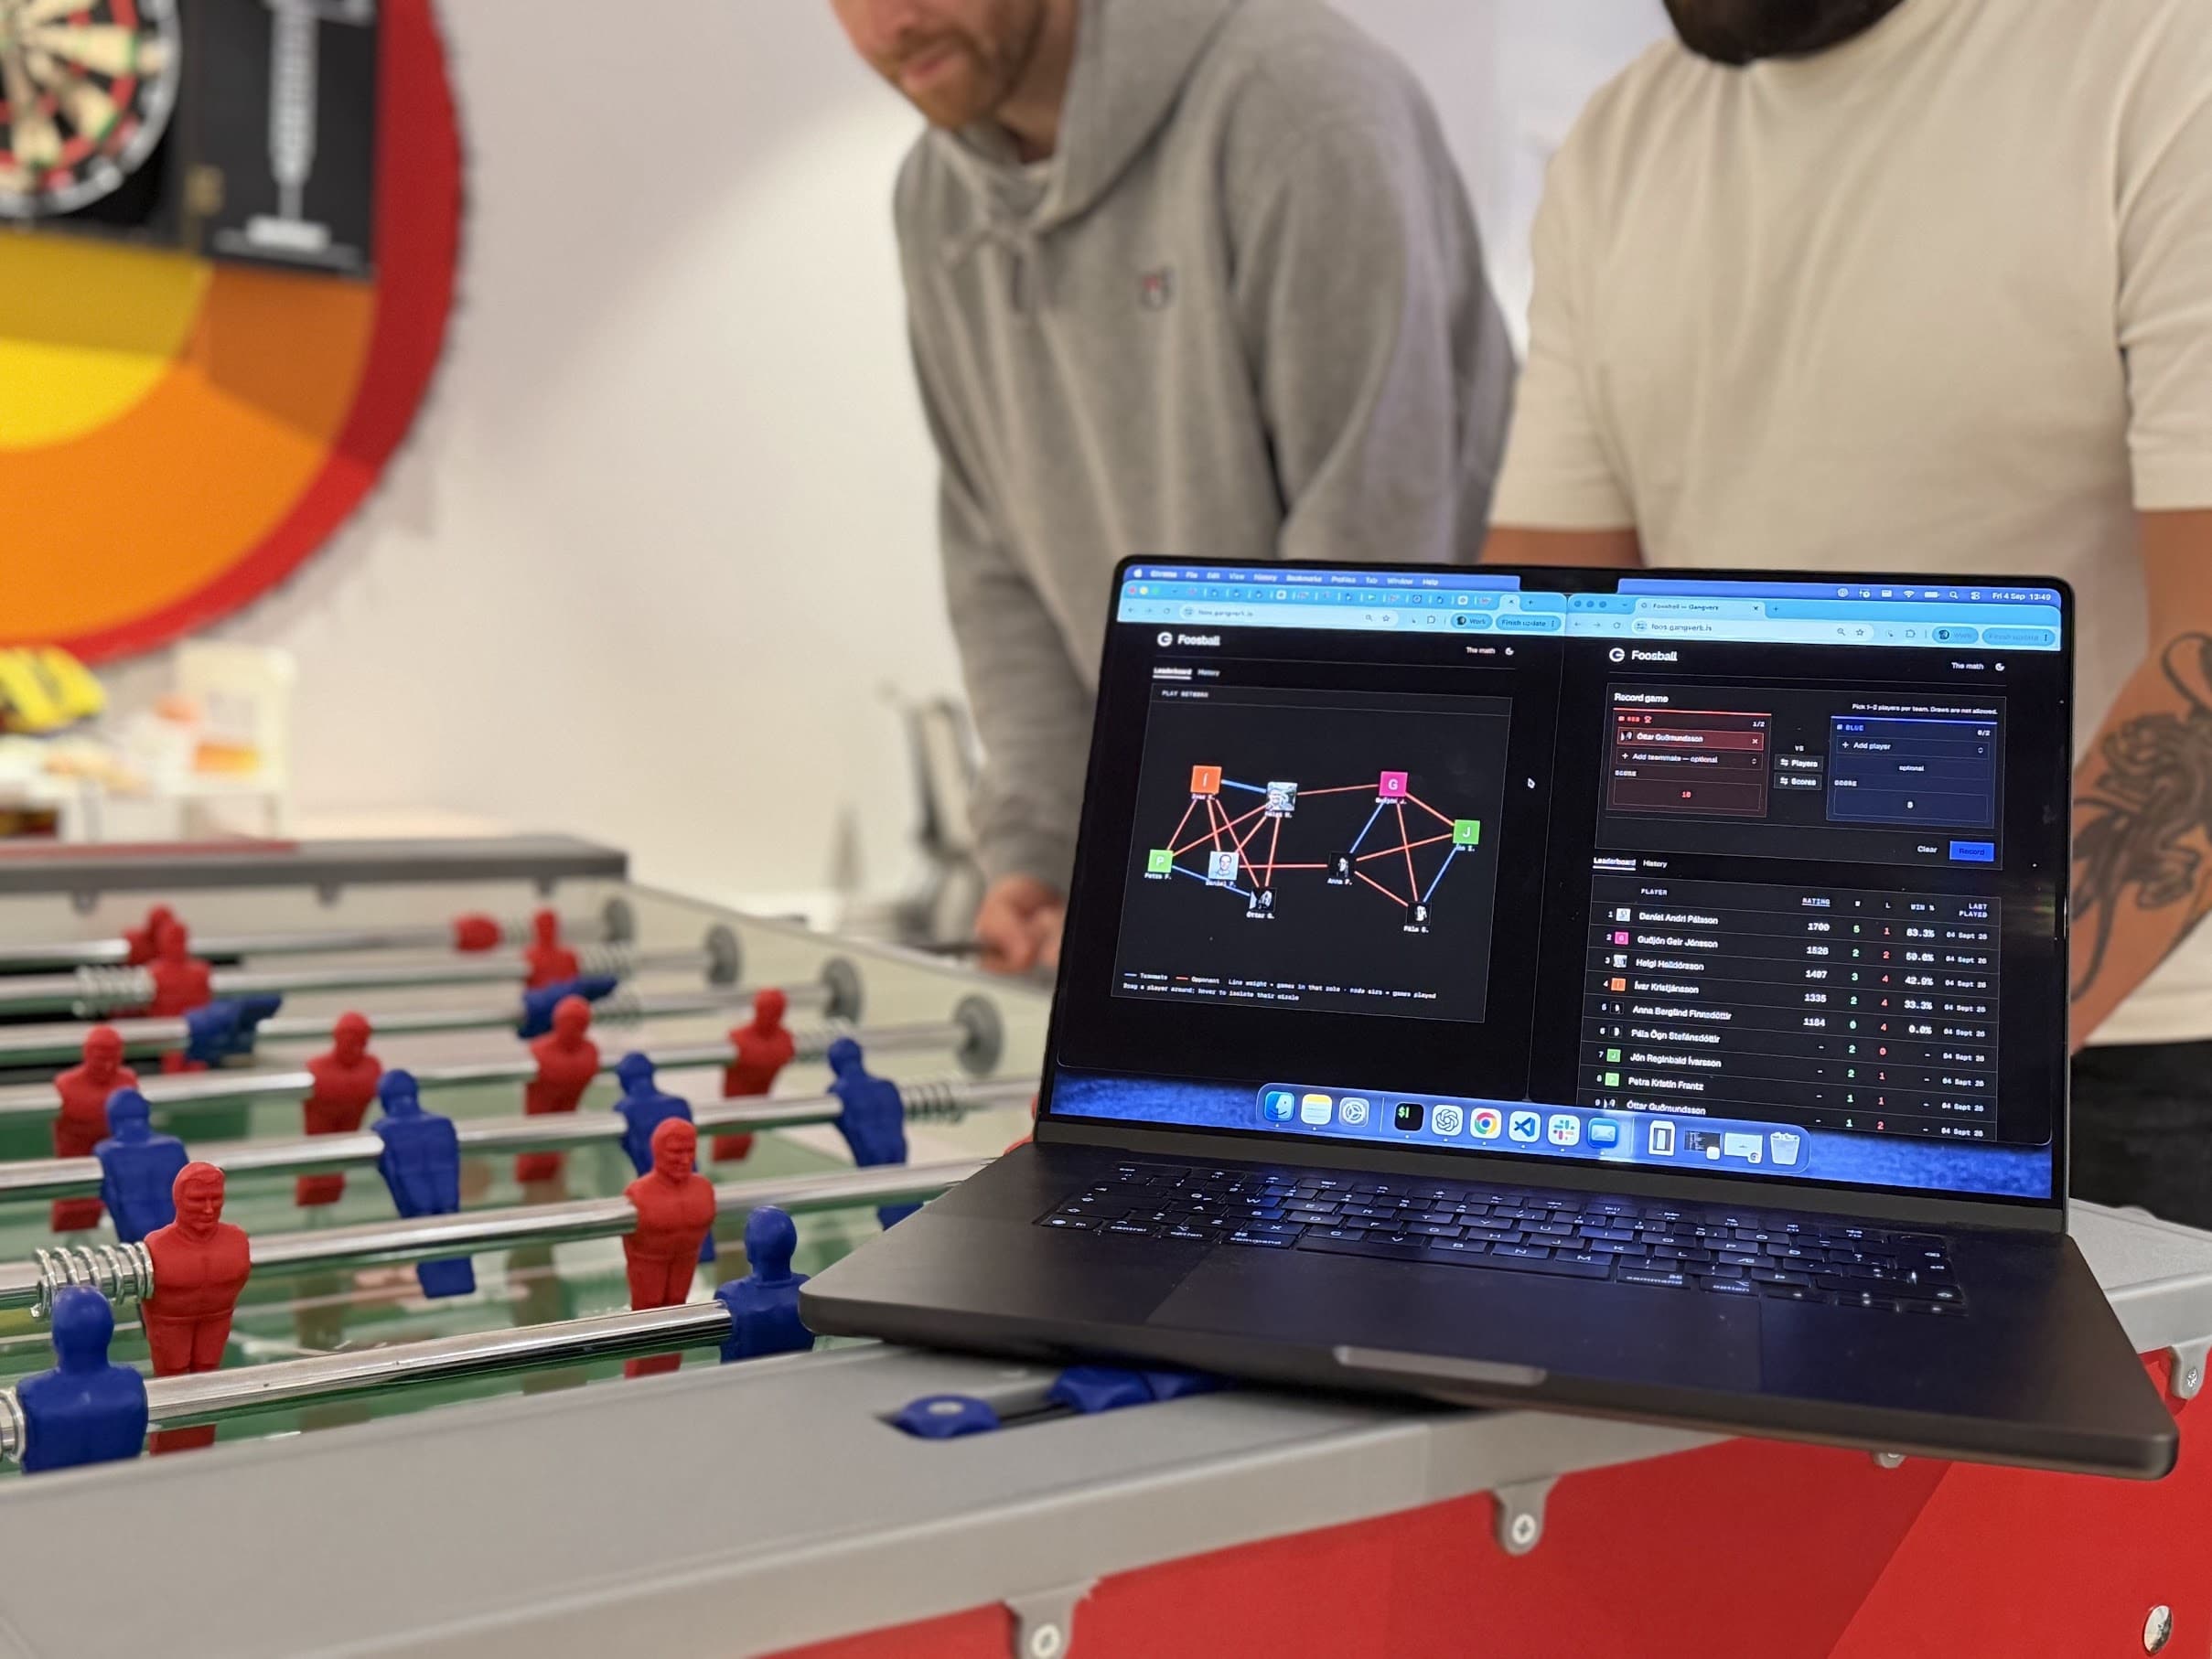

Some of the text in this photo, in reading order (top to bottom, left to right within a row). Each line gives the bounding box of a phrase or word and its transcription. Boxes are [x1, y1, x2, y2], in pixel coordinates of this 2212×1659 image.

[1207, 572, 1219, 580] Edit
[1366, 576, 1379, 584] Tab
[1387, 577, 1413, 585] Window
[1423, 578, 1439, 586] Help
[1469, 617, 1487, 626] Work
[1522, 620, 1546, 628] update
[1177, 634, 1220, 647] Foosball
[1466, 646, 1496, 655] The math
[1631, 649, 1678, 661] Foosball
[1951, 661, 1984, 670] The math
[1614, 692, 1670, 704] Record game
[1853, 742, 1892, 752] Add player
[1632, 753, 1647, 761] Add
[1690, 755, 1718, 765] optional
[1791, 759, 1819, 770] Players
[1899, 765, 1925, 774] optional
[1388, 779, 1398, 790] G
[1791, 777, 1817, 787] Scores
[1463, 827, 1471, 838] J
[1917, 845, 1938, 854] Clear
[1959, 848, 1985, 857] Record
[1155, 856, 1165, 866] P
[1593, 857, 1668, 868] Leaderboard History
[1640, 888, 1668, 896] PLAYER
[1853, 925, 1860, 933] 5
[1852, 949, 1859, 958] 2
[1883, 951, 1890, 959] 2
[1637, 958, 1657, 969] Helgi
[1852, 972, 1858, 980] 3
[1850, 996, 1857, 1005] 2
[1633, 1006, 1654, 1016] Anna
[1880, 1023, 1887, 1032] 4
[1849, 1044, 1855, 1054] 2
[1598, 1051, 1604, 1059] 7
[1848, 1069, 1855, 1078] 2
[1878, 1072, 1885, 1080] 1
[1628, 1076, 1650, 1087] Petra
[1678, 1081, 1704, 1092] Frantz
[1847, 1094, 1854, 1103] 1
[1878, 1097, 1884, 1106] 1
[1846, 1118, 1852, 1128] 1
[1877, 1121, 1884, 1130] 2
